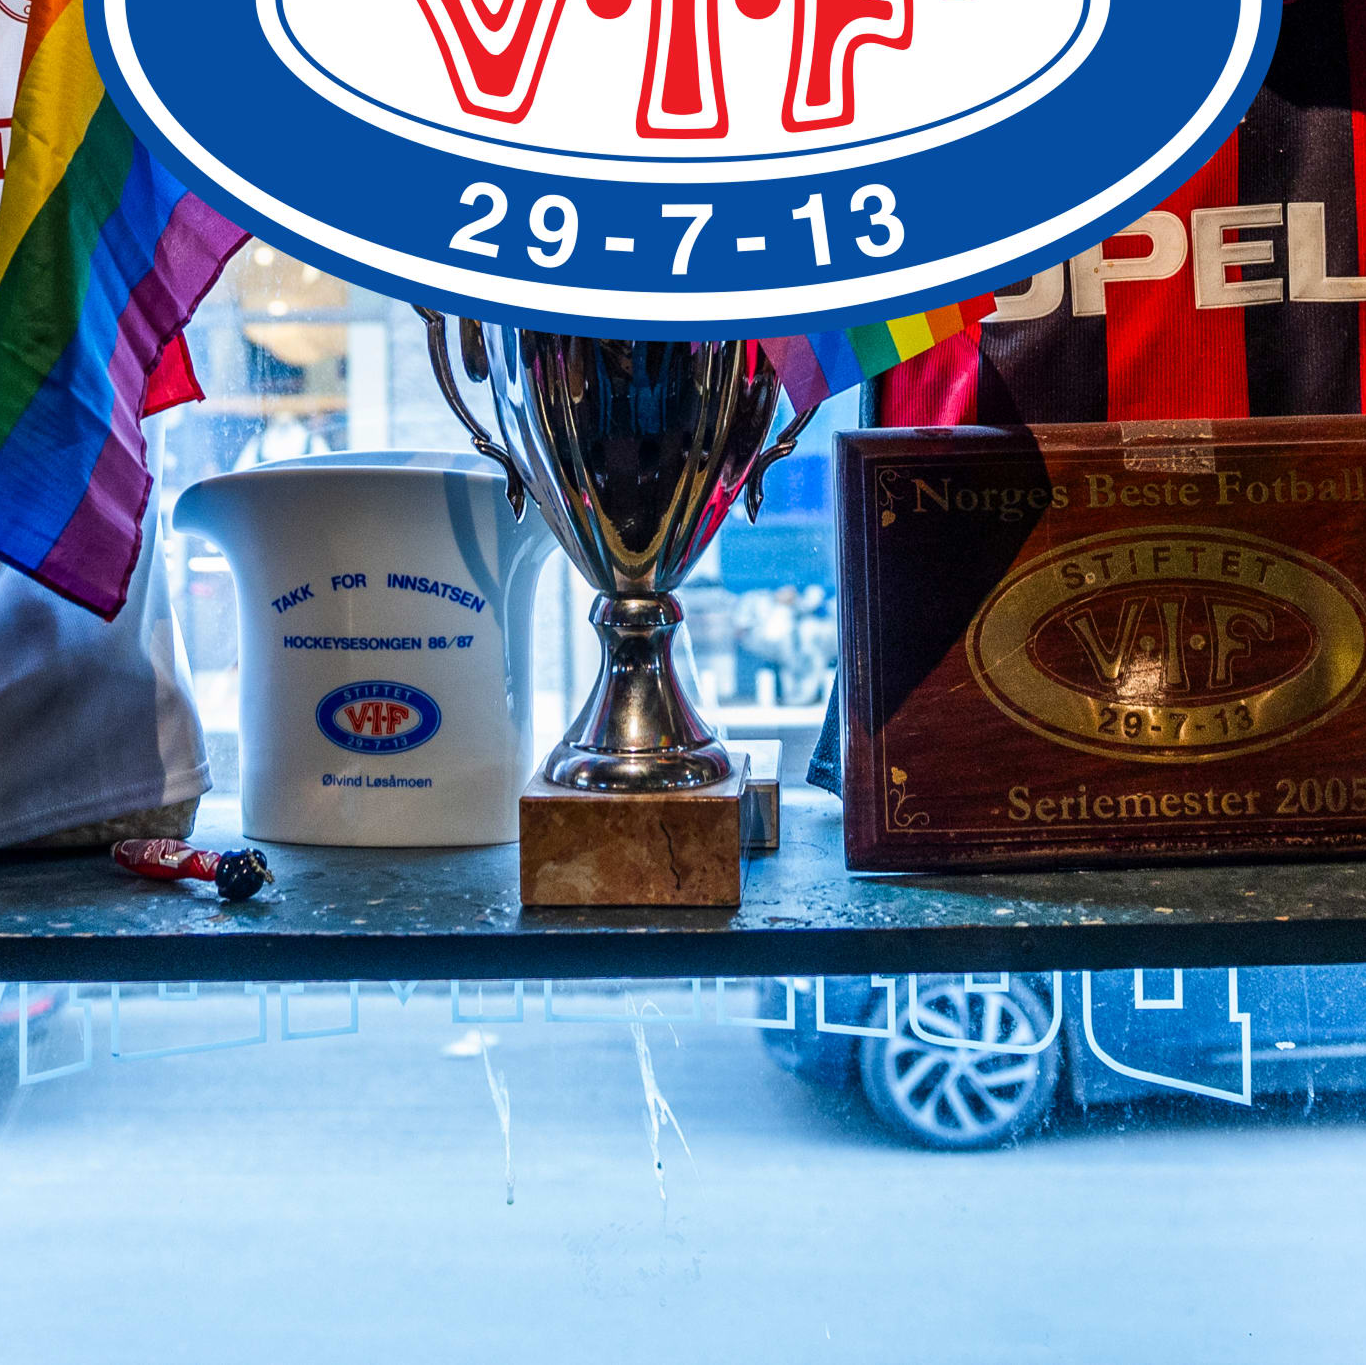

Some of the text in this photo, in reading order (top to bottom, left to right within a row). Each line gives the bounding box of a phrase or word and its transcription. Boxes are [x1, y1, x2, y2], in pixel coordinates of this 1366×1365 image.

[913, 476, 1069, 523] Norges
[1085, 472, 1201, 510] Beste
[1061, 546, 1277, 591] STIFTET
[271, 573, 485, 614] TAKK FOR INNSATSEN
[284, 635, 475, 651] HOCKEYSESONGEN 86/87
[343, 685, 412, 701] STIFTET
[1098, 705, 1255, 740] 29-7-13
[347, 736, 408, 750] 29-7-13
[322, 773, 432, 788] Øivind Løsåmoen
[1007, 783, 1261, 825] Seriemester
